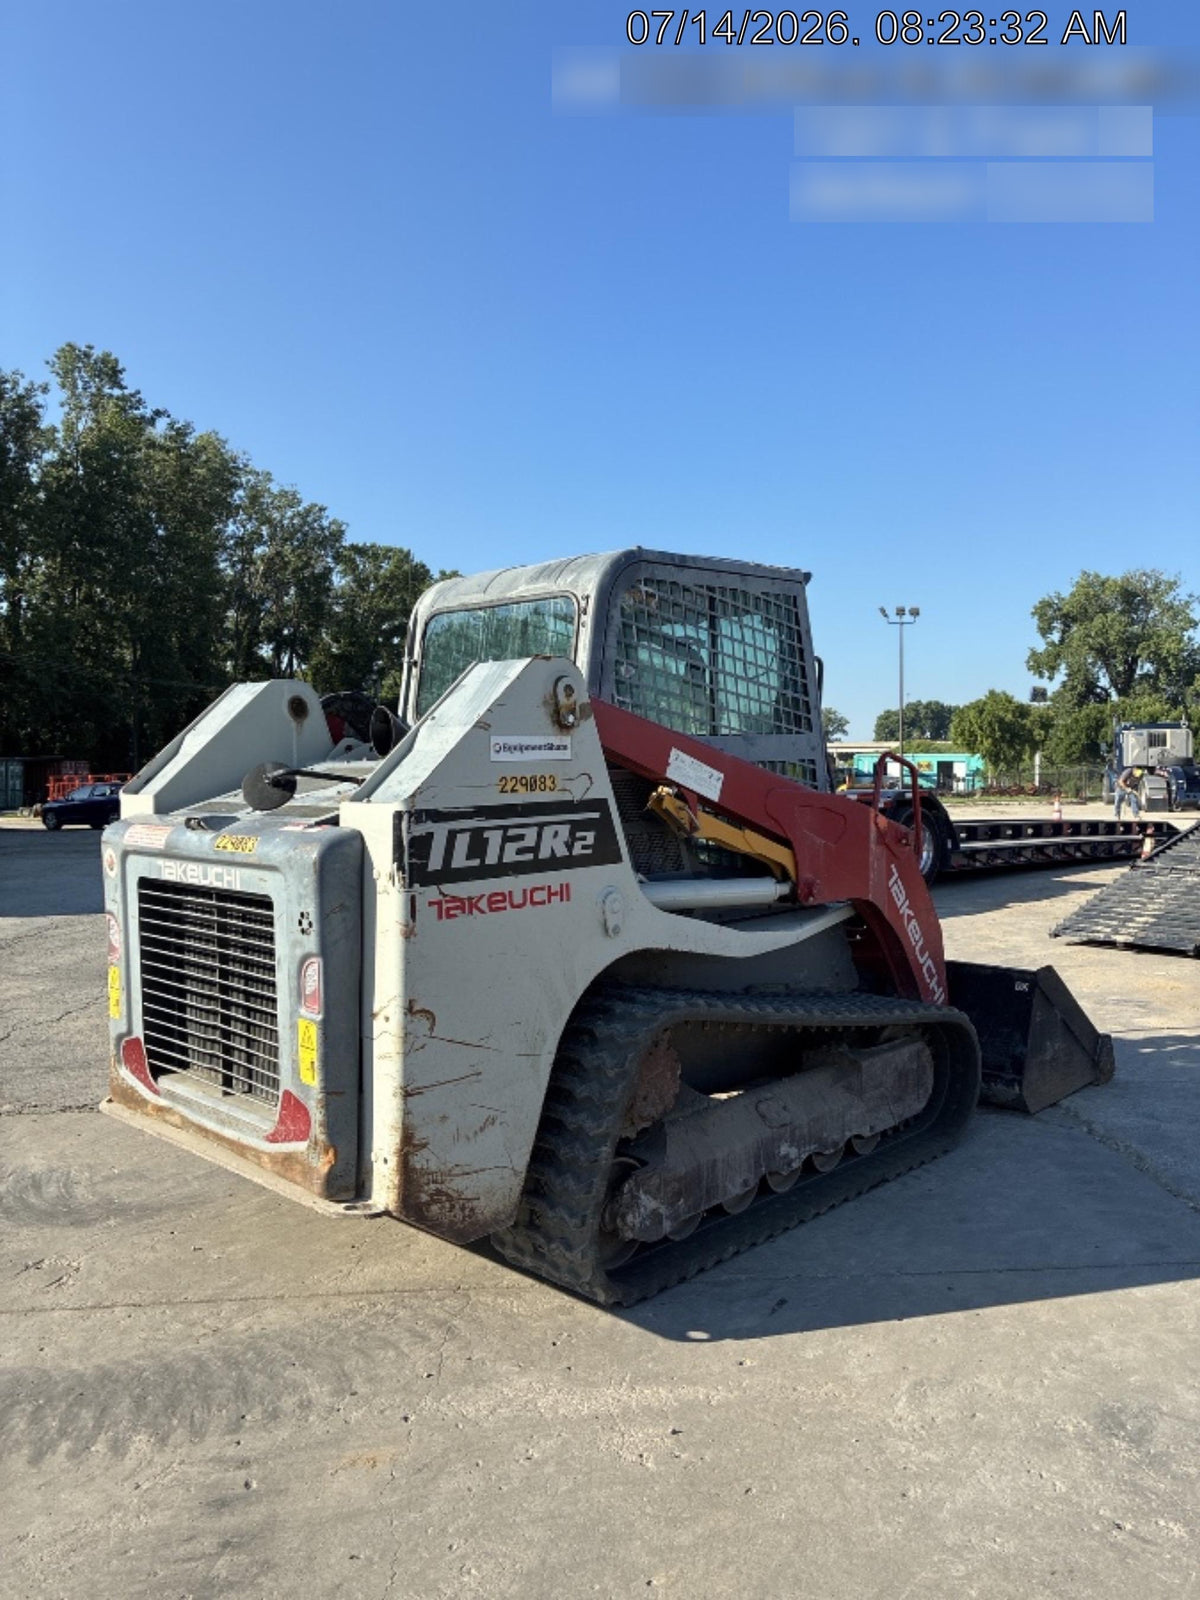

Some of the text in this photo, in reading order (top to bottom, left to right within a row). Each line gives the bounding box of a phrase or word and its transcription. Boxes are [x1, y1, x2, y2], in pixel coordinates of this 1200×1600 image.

[499, 774, 557, 793] 229083
[157, 859, 241, 890] TAKEUCHI
[428, 882, 571, 921] TAKEUCHI
